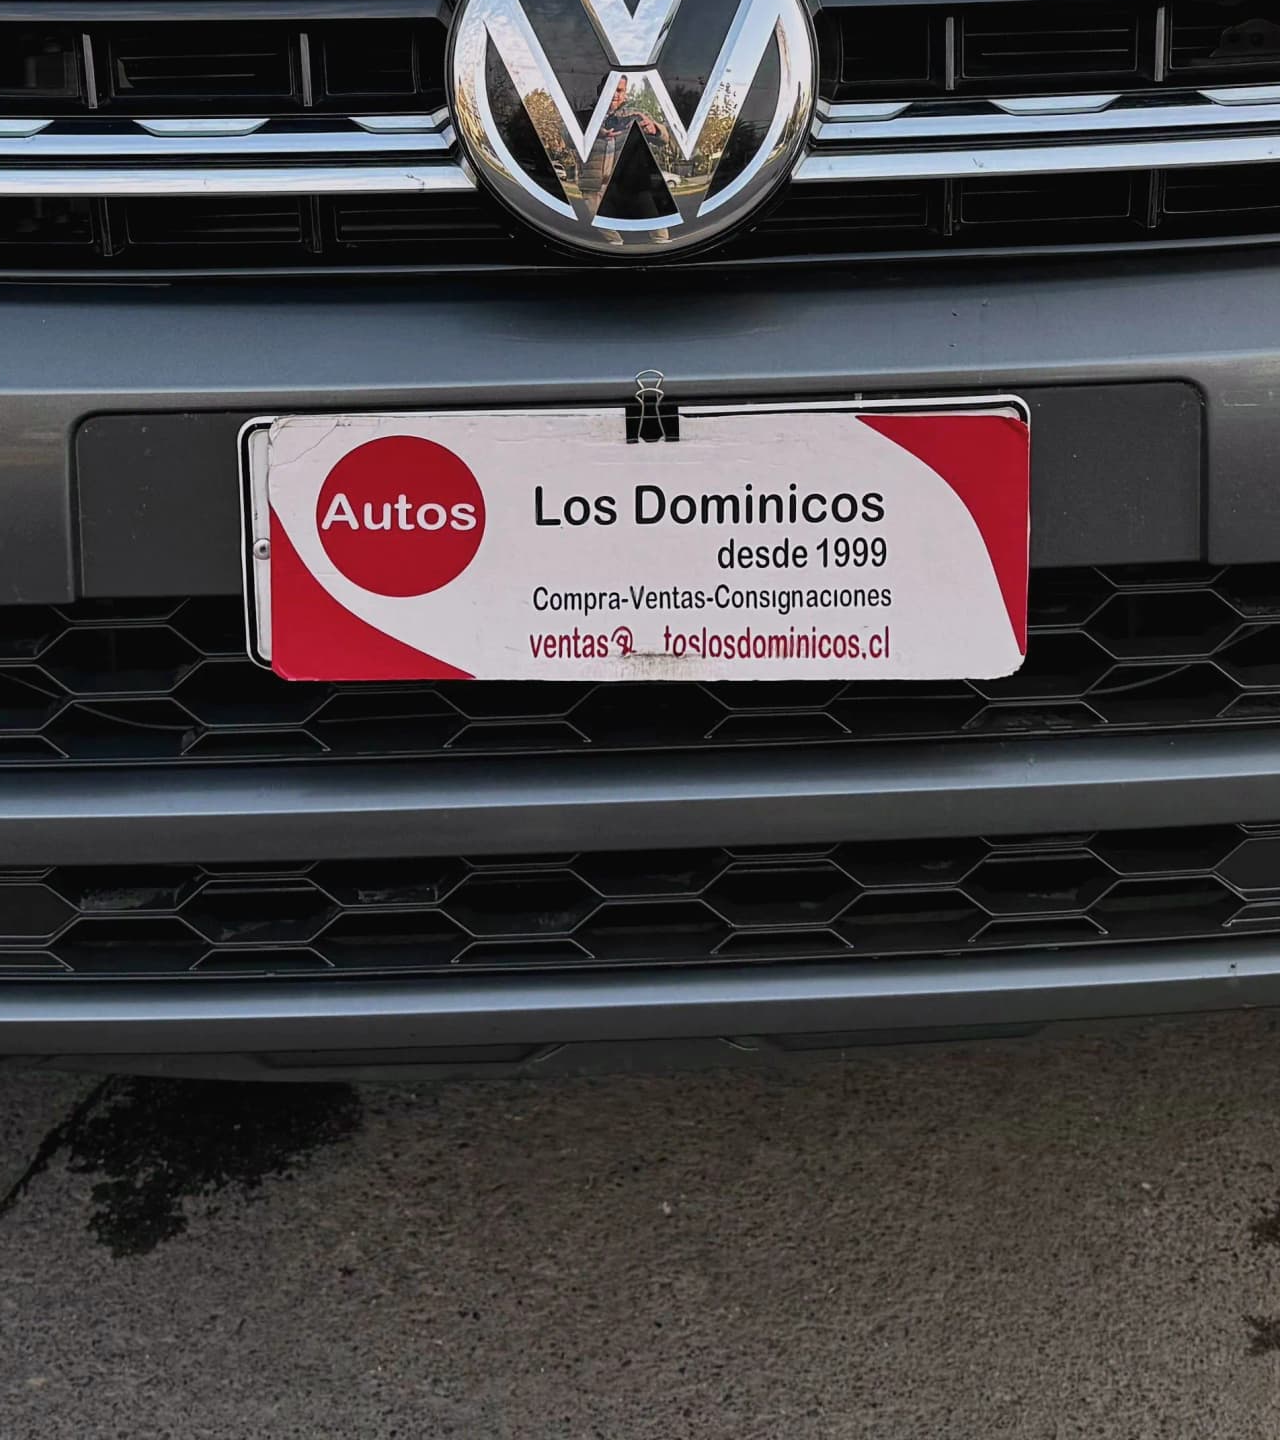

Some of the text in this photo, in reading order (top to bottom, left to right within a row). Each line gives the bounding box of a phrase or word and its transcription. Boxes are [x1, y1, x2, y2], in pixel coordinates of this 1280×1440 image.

[321, 492, 477, 531] Autos
[534, 483, 885, 527] Los Dominicos
[717, 537, 887, 569] desde 1999
